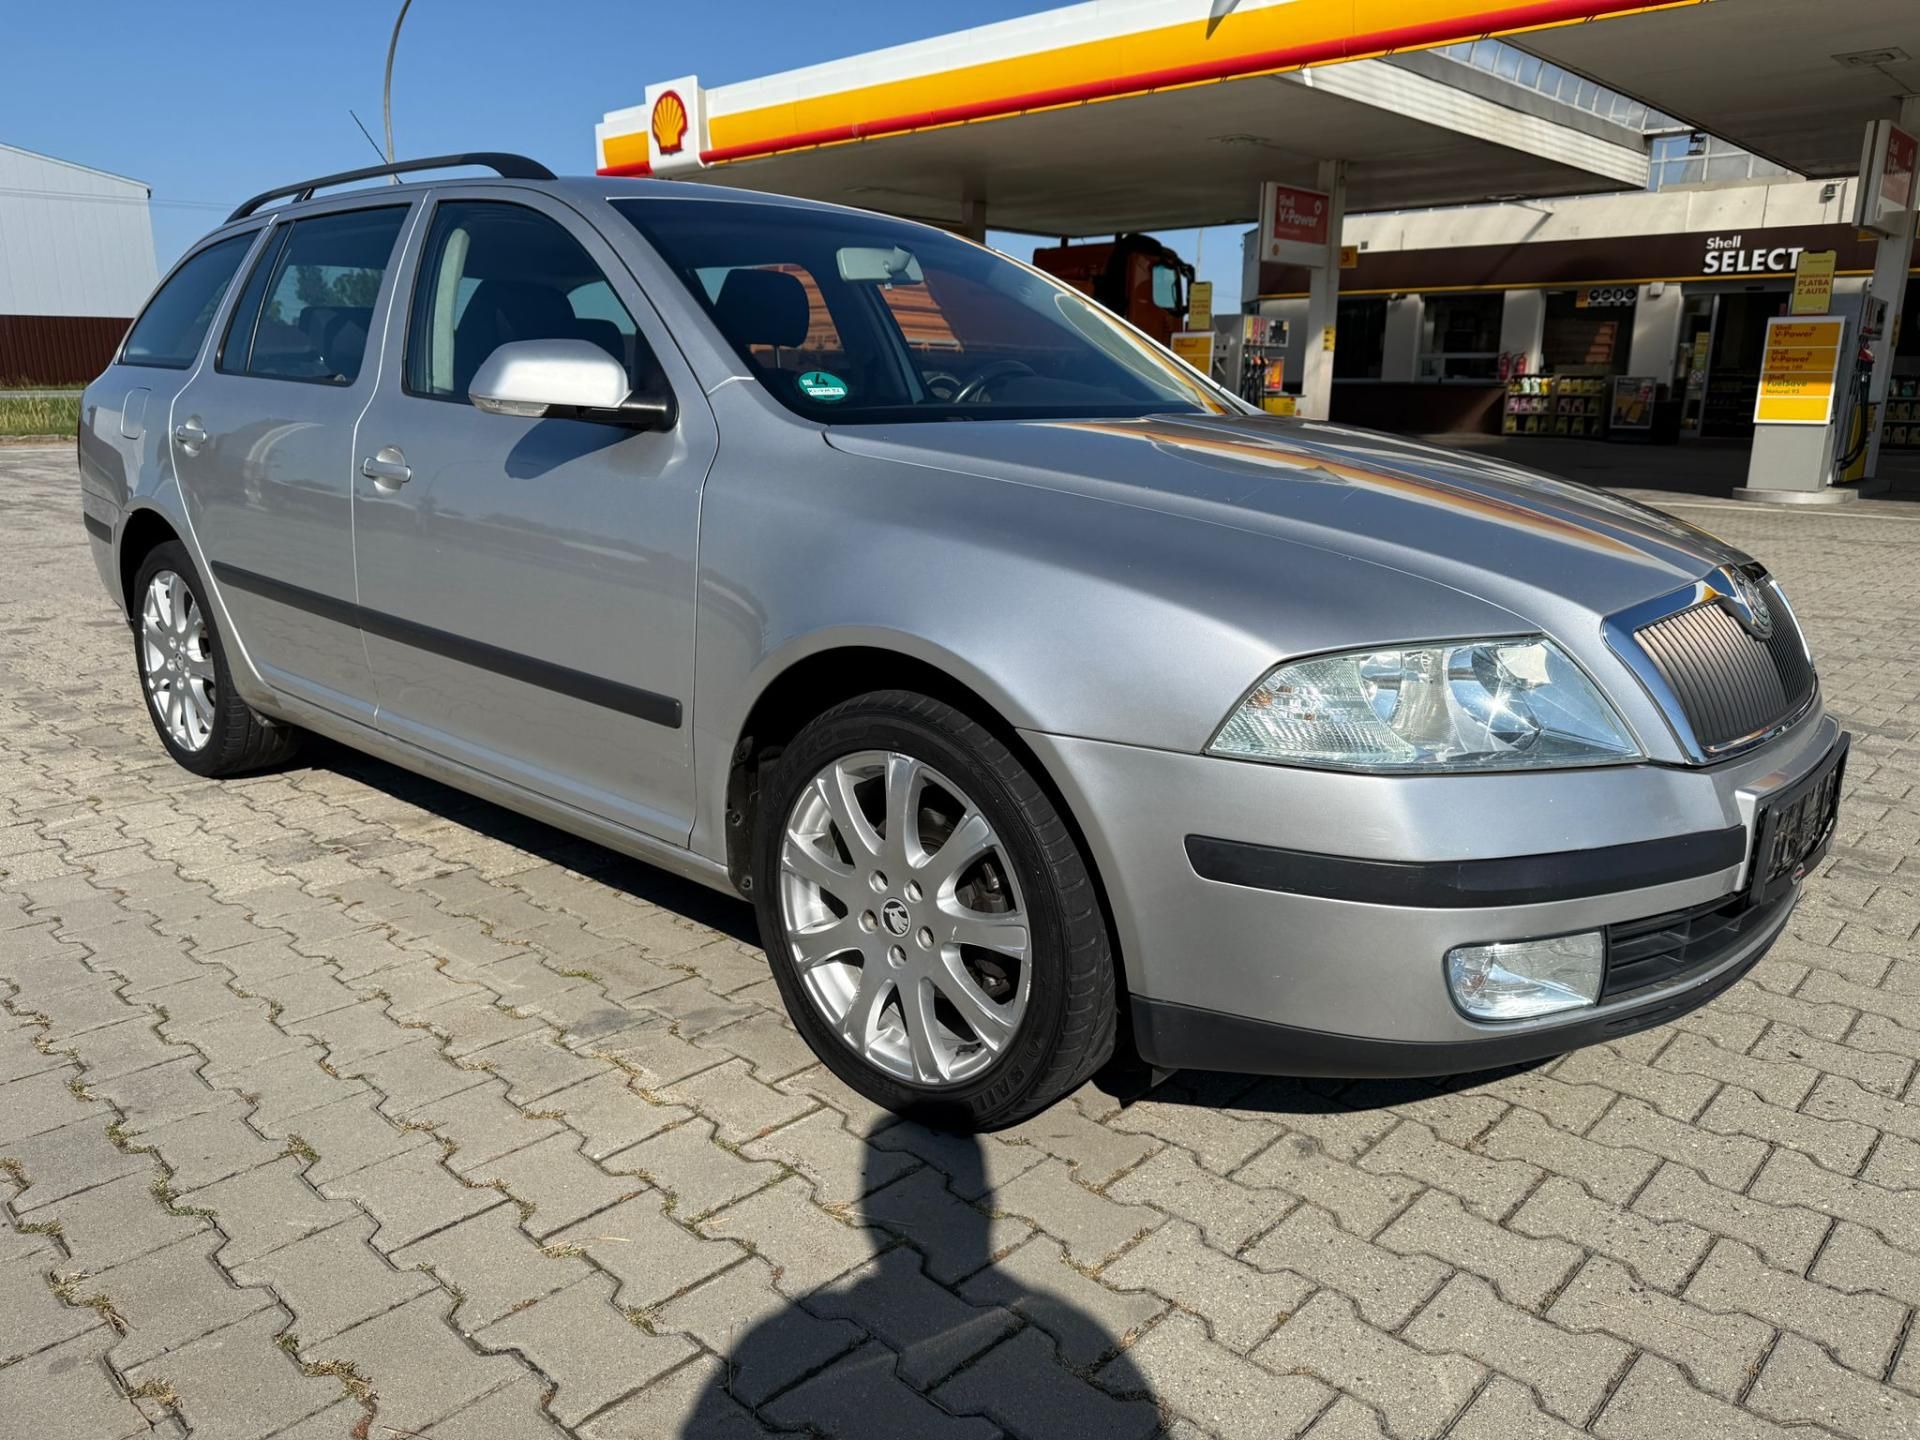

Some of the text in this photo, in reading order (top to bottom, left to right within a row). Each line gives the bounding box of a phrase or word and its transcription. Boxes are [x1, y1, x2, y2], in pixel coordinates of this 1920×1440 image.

[1279, 207, 1318, 227] V-Power
[1706, 235, 1742, 249] Shell
[1703, 247, 1804, 274] SELECT
[1798, 279, 1829, 287] PLATBA
[1805, 287, 1828, 295] AUTA
[1775, 330, 1813, 338] V-Power
[815, 373, 829, 386] 4
[970, 1064, 1025, 1115] SAIL
